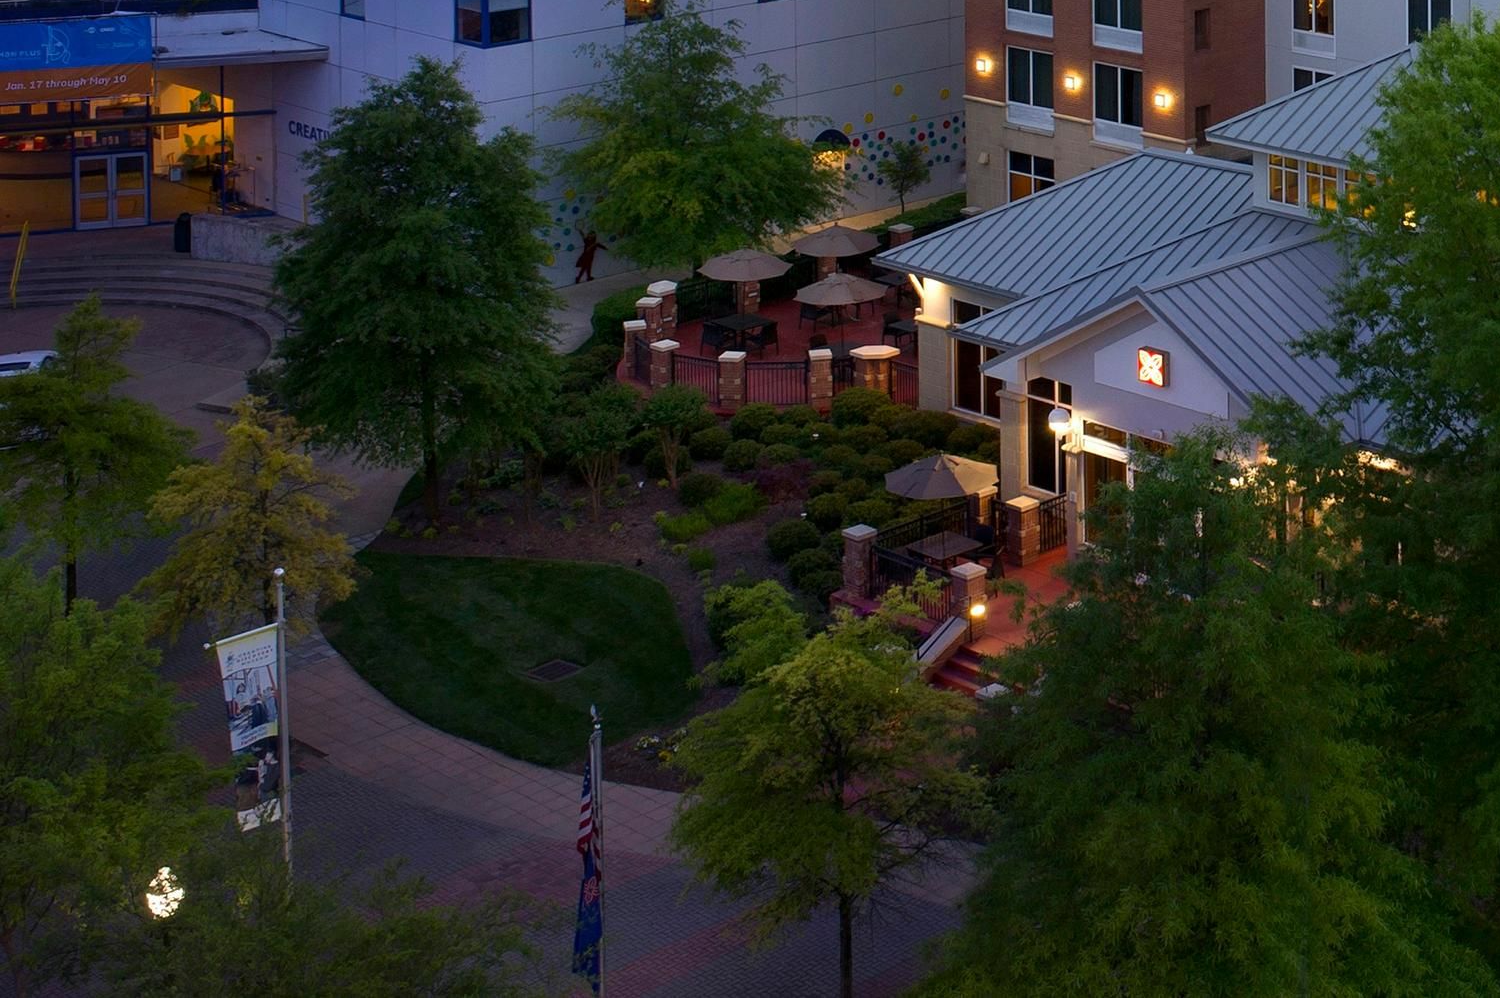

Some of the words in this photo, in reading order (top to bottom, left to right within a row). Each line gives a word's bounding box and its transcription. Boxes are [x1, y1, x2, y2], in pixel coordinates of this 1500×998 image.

[5, 81, 26, 91] Jan.
[29, 80, 43, 89] 17
[45, 76, 87, 89] through
[88, 75, 111, 86] May
[112, 74, 127, 84] 10
